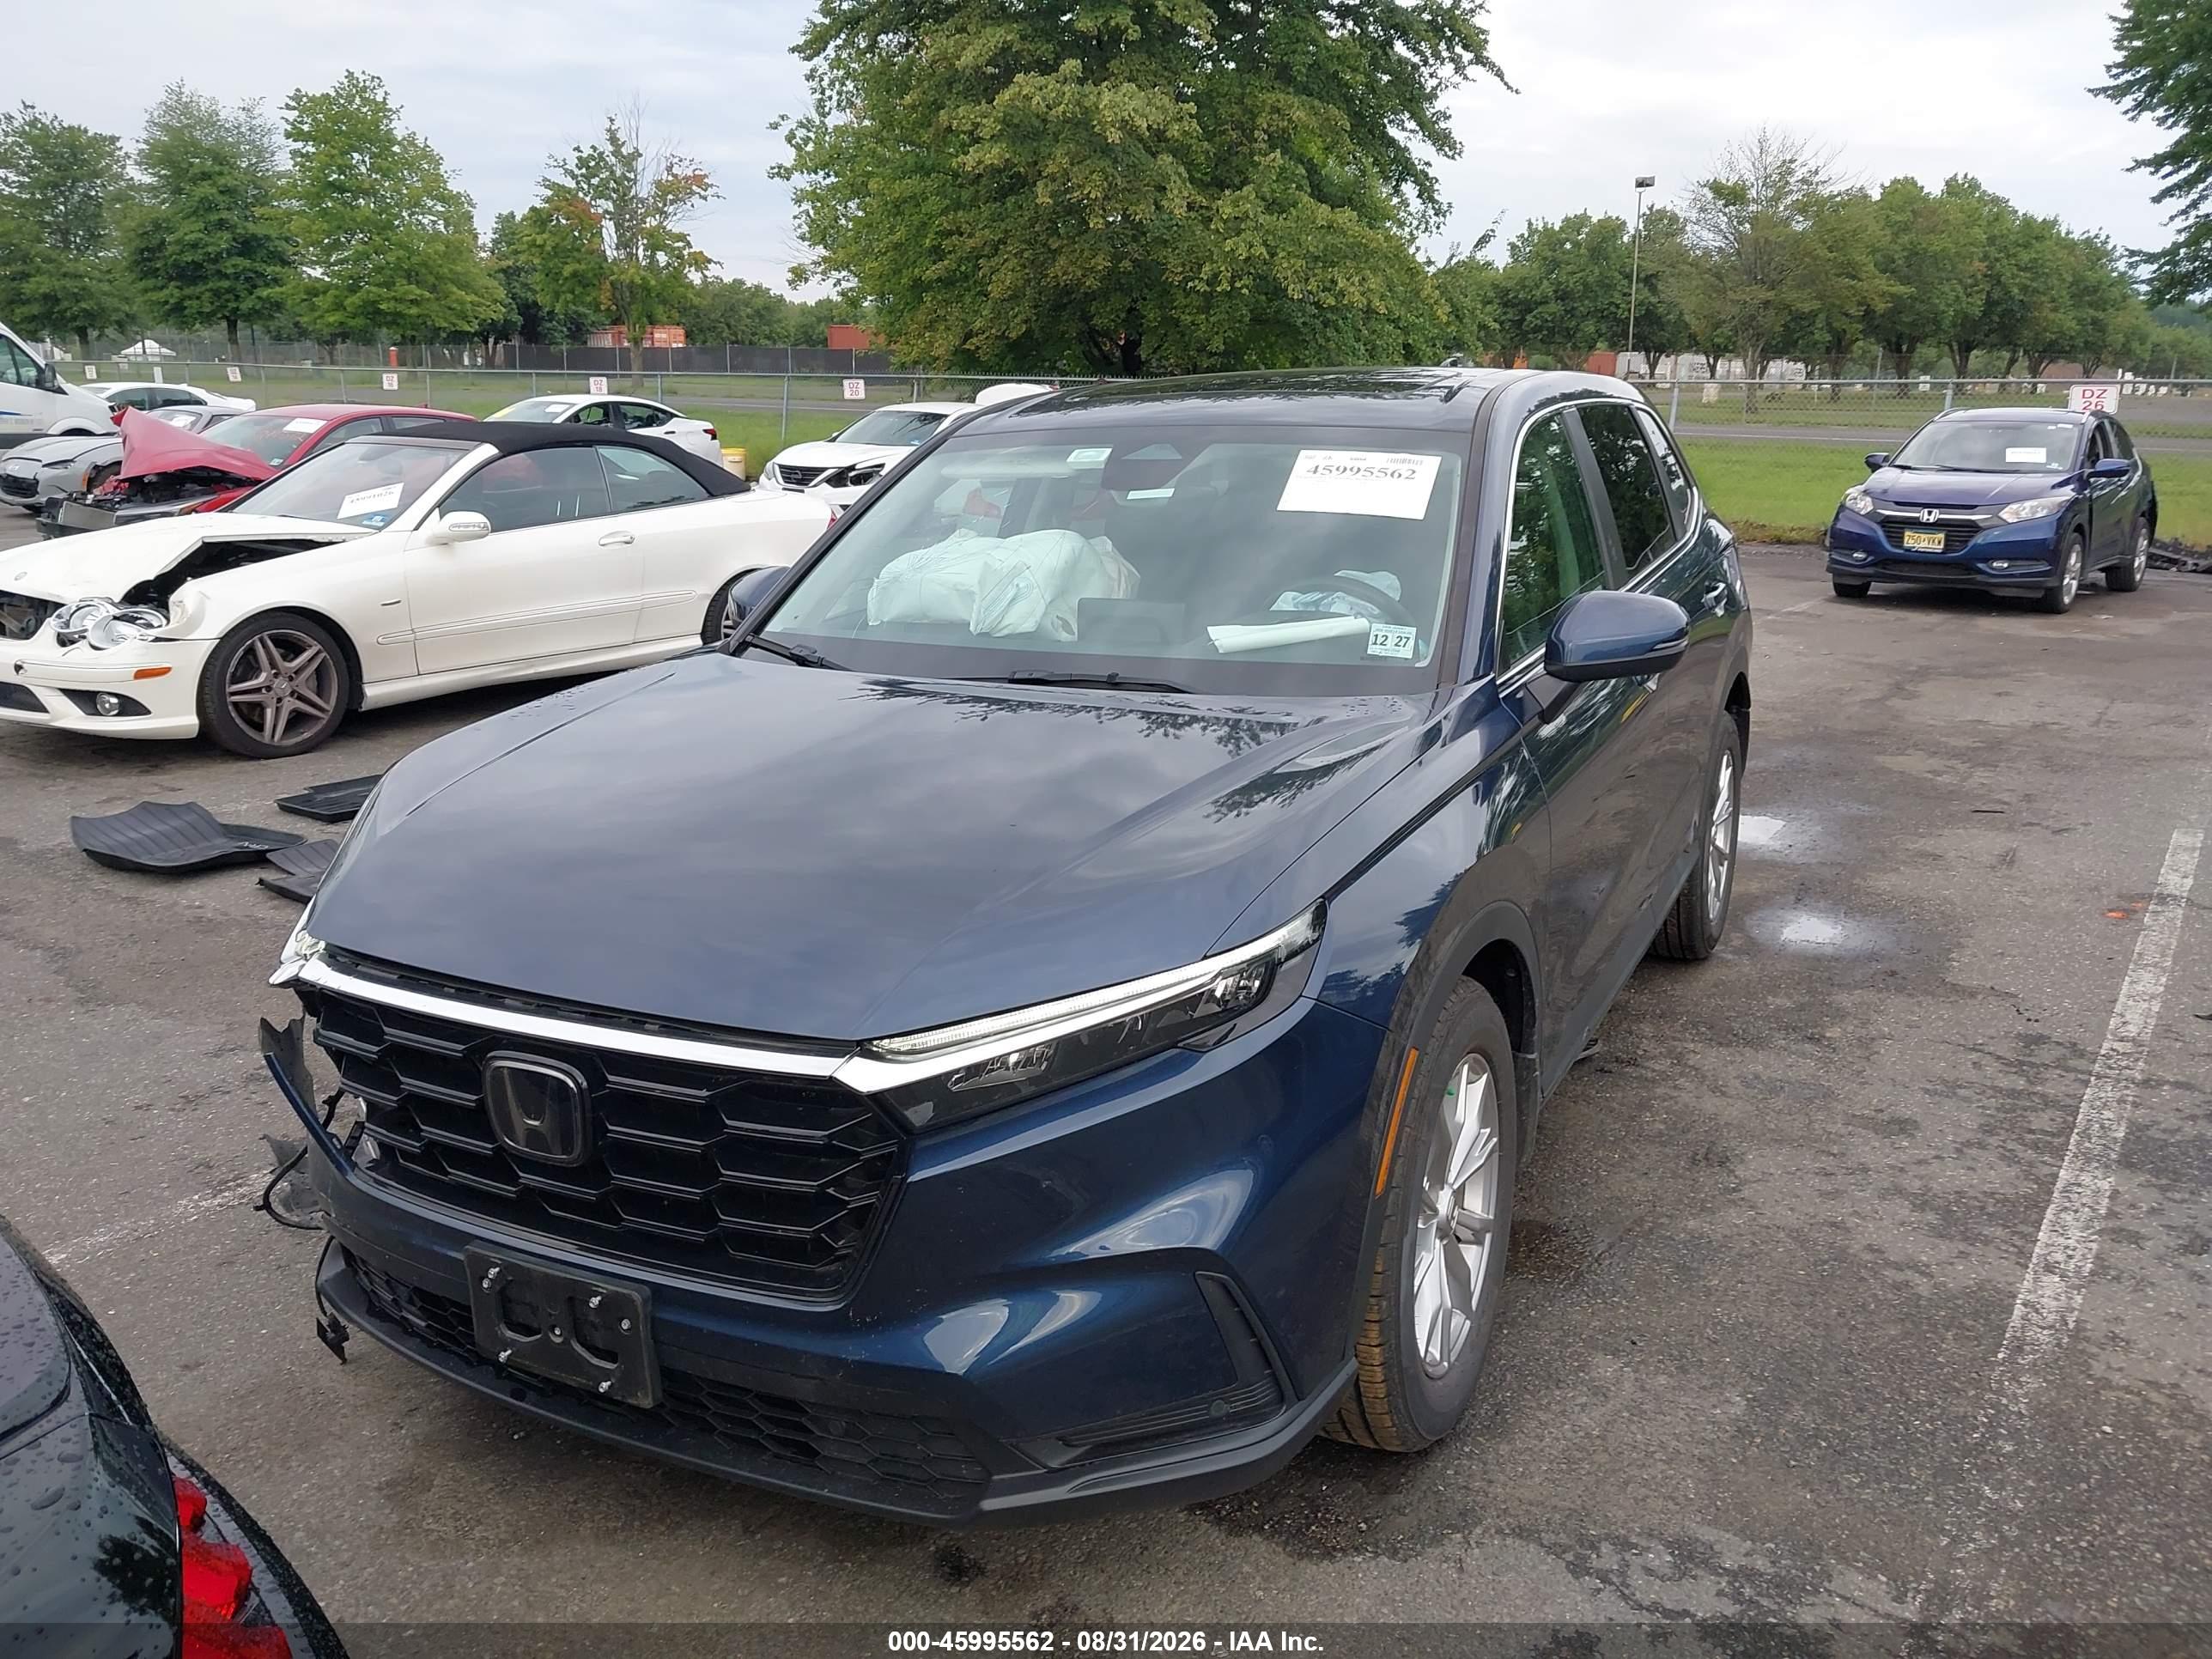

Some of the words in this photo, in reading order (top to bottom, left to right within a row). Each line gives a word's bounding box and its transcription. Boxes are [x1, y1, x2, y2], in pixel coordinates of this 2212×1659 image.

[2081, 388, 2108, 399] DZ
[2081, 400, 2105, 411] 26
[1306, 464, 1418, 480] 45995562
[1371, 634, 1389, 647] 12
[1394, 635, 1412, 648] 27
